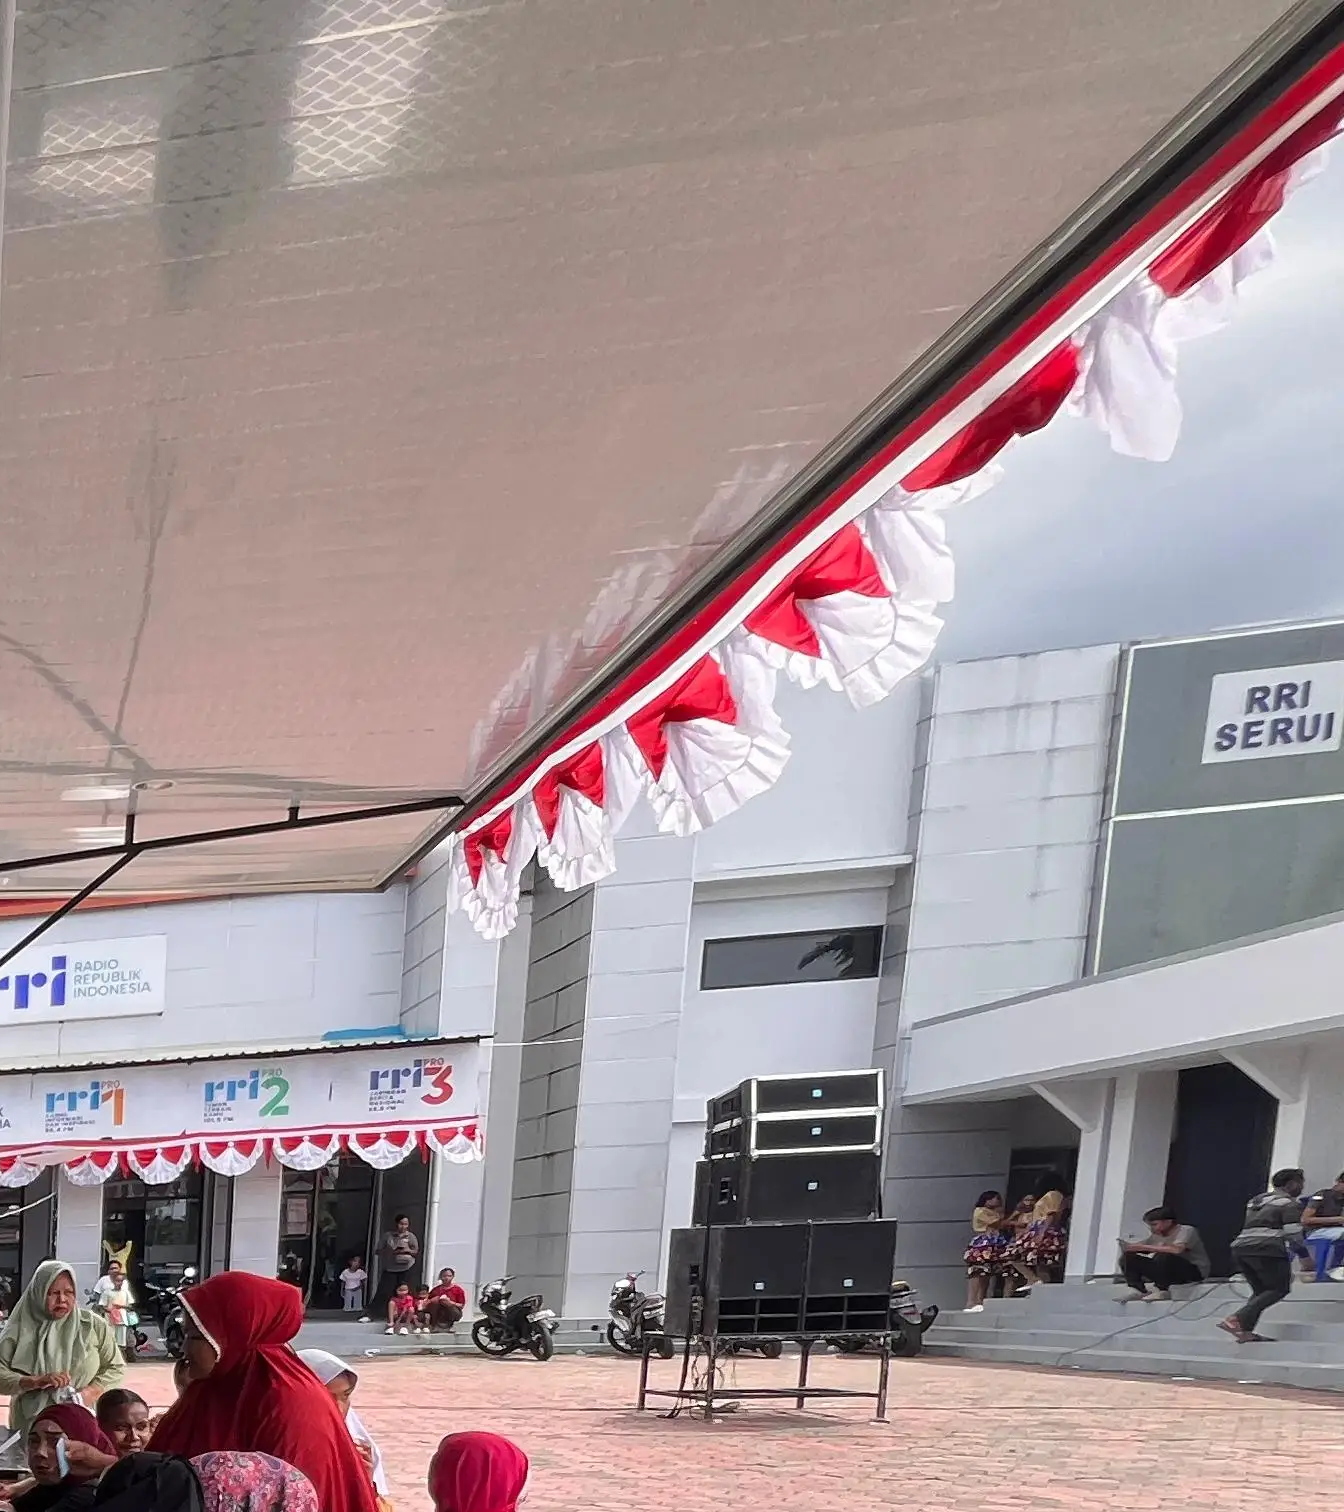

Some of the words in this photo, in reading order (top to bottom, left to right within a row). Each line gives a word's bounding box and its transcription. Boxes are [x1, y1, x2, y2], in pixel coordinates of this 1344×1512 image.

[1244, 679, 1312, 717] RRI
[1214, 711, 1335, 752] SERUI
[73, 969, 143, 986] REPUBLIK
[74, 959, 119, 973] RADIO
[73, 982, 152, 999] INDONESIA
[370, 1059, 422, 1091] rri
[46, 1081, 100, 1112] rri
[205, 1070, 259, 1102] rri
[259, 1076, 289, 1117] 2
